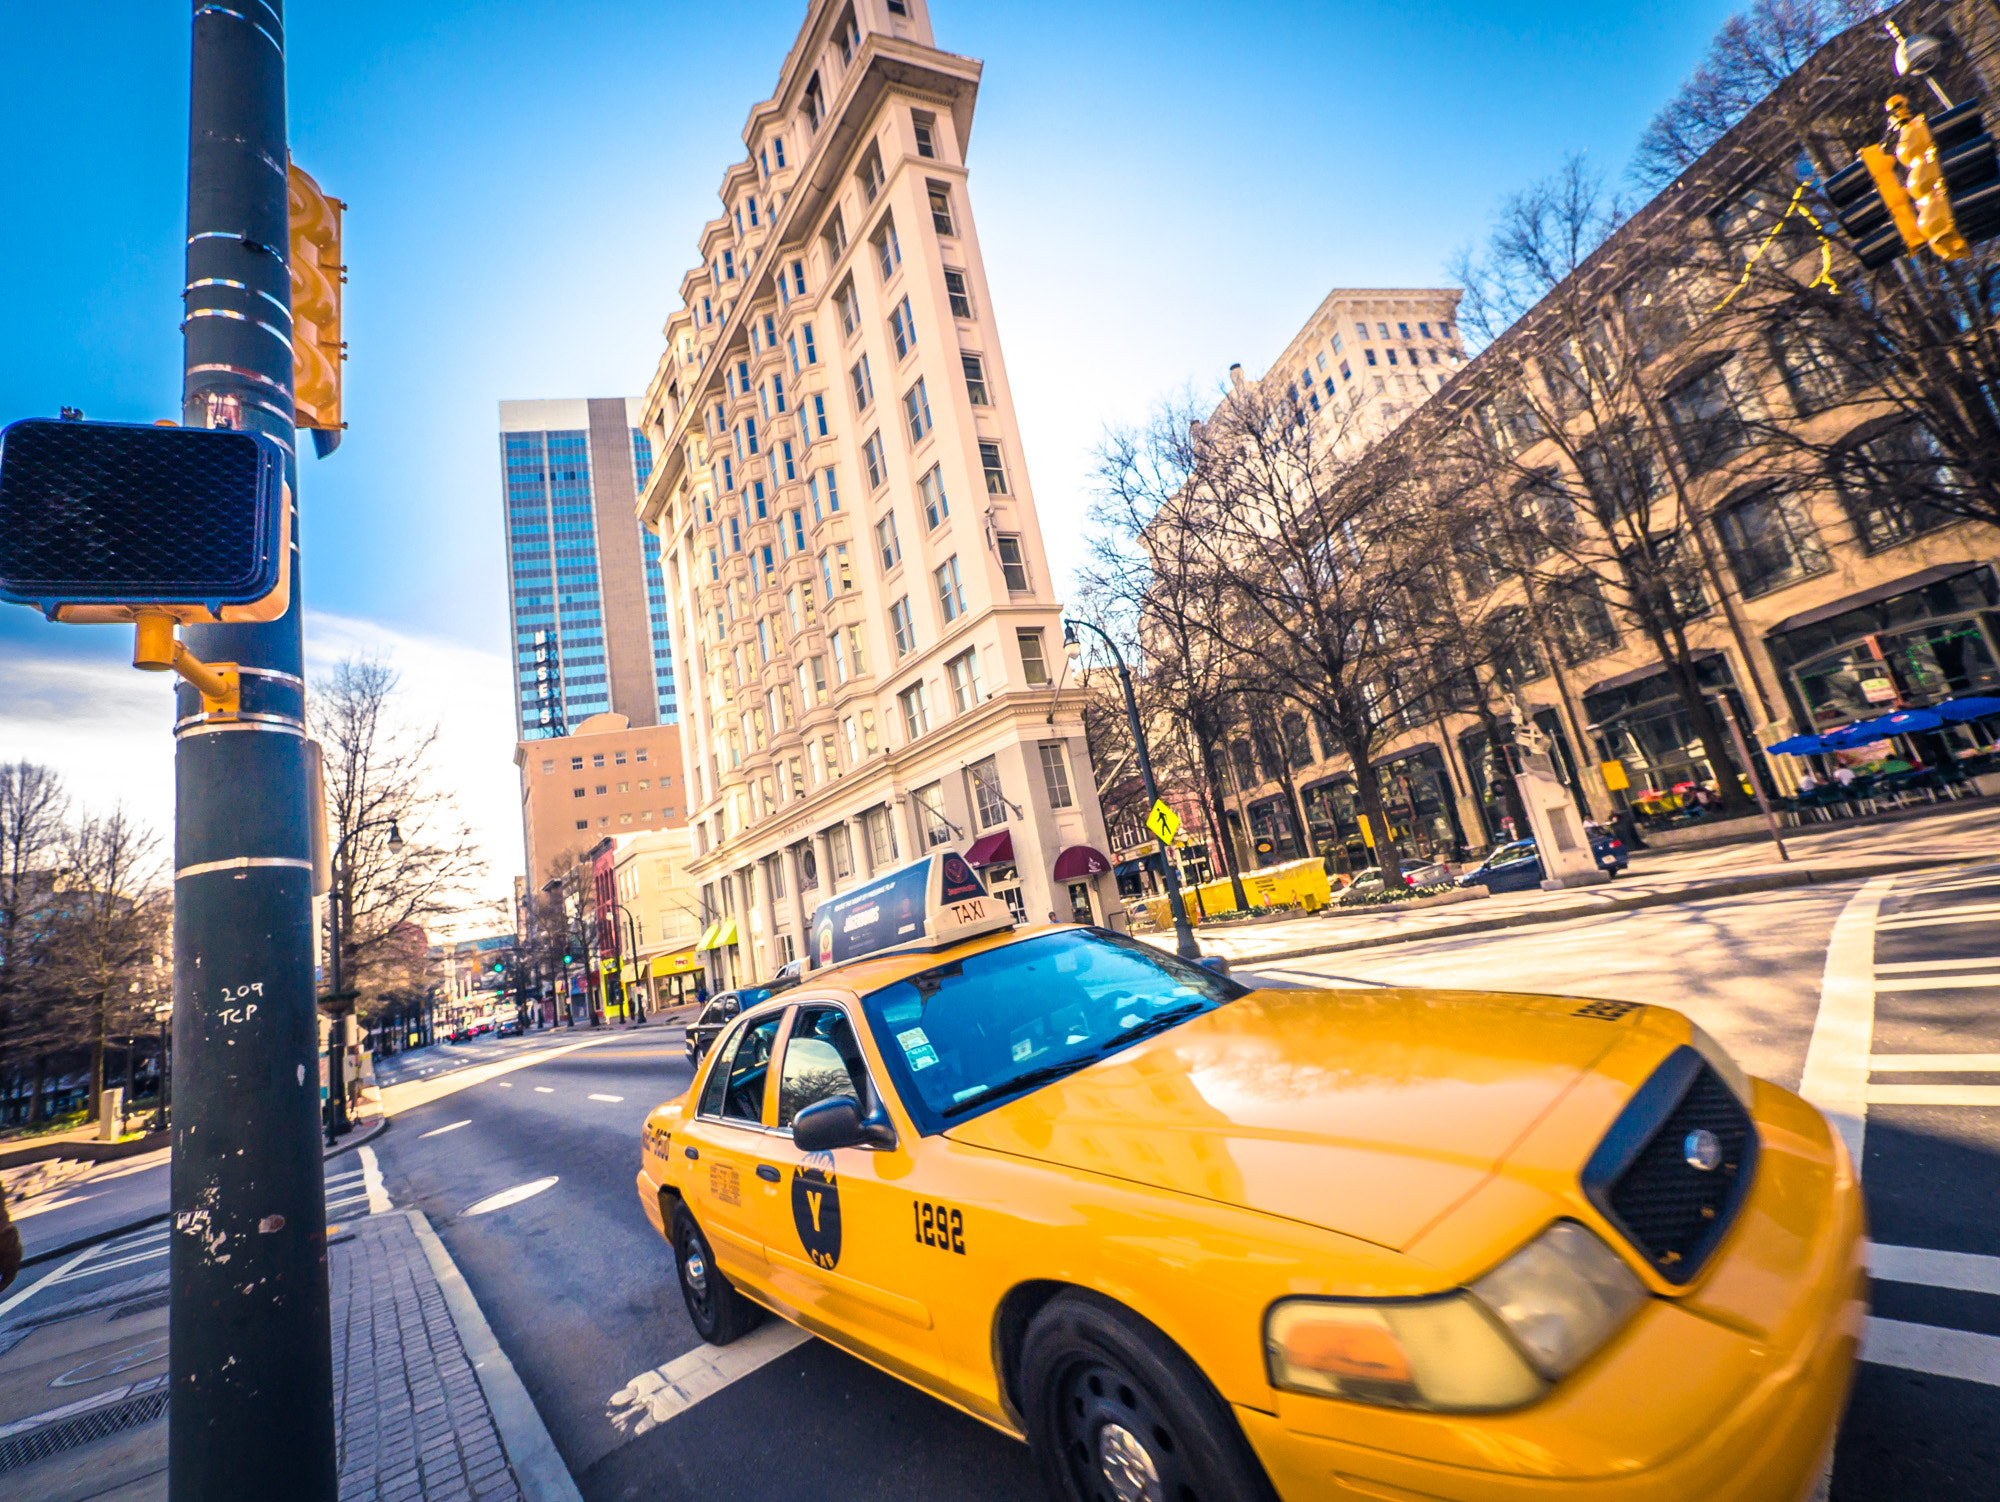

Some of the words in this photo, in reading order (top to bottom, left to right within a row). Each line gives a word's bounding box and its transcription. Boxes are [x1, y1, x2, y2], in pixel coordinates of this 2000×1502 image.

[951, 900, 985, 924] TAXI
[221, 982, 264, 1002] 209
[218, 1004, 258, 1026] TCP
[806, 1190, 823, 1232] Y
[913, 1200, 967, 1256] 1292
